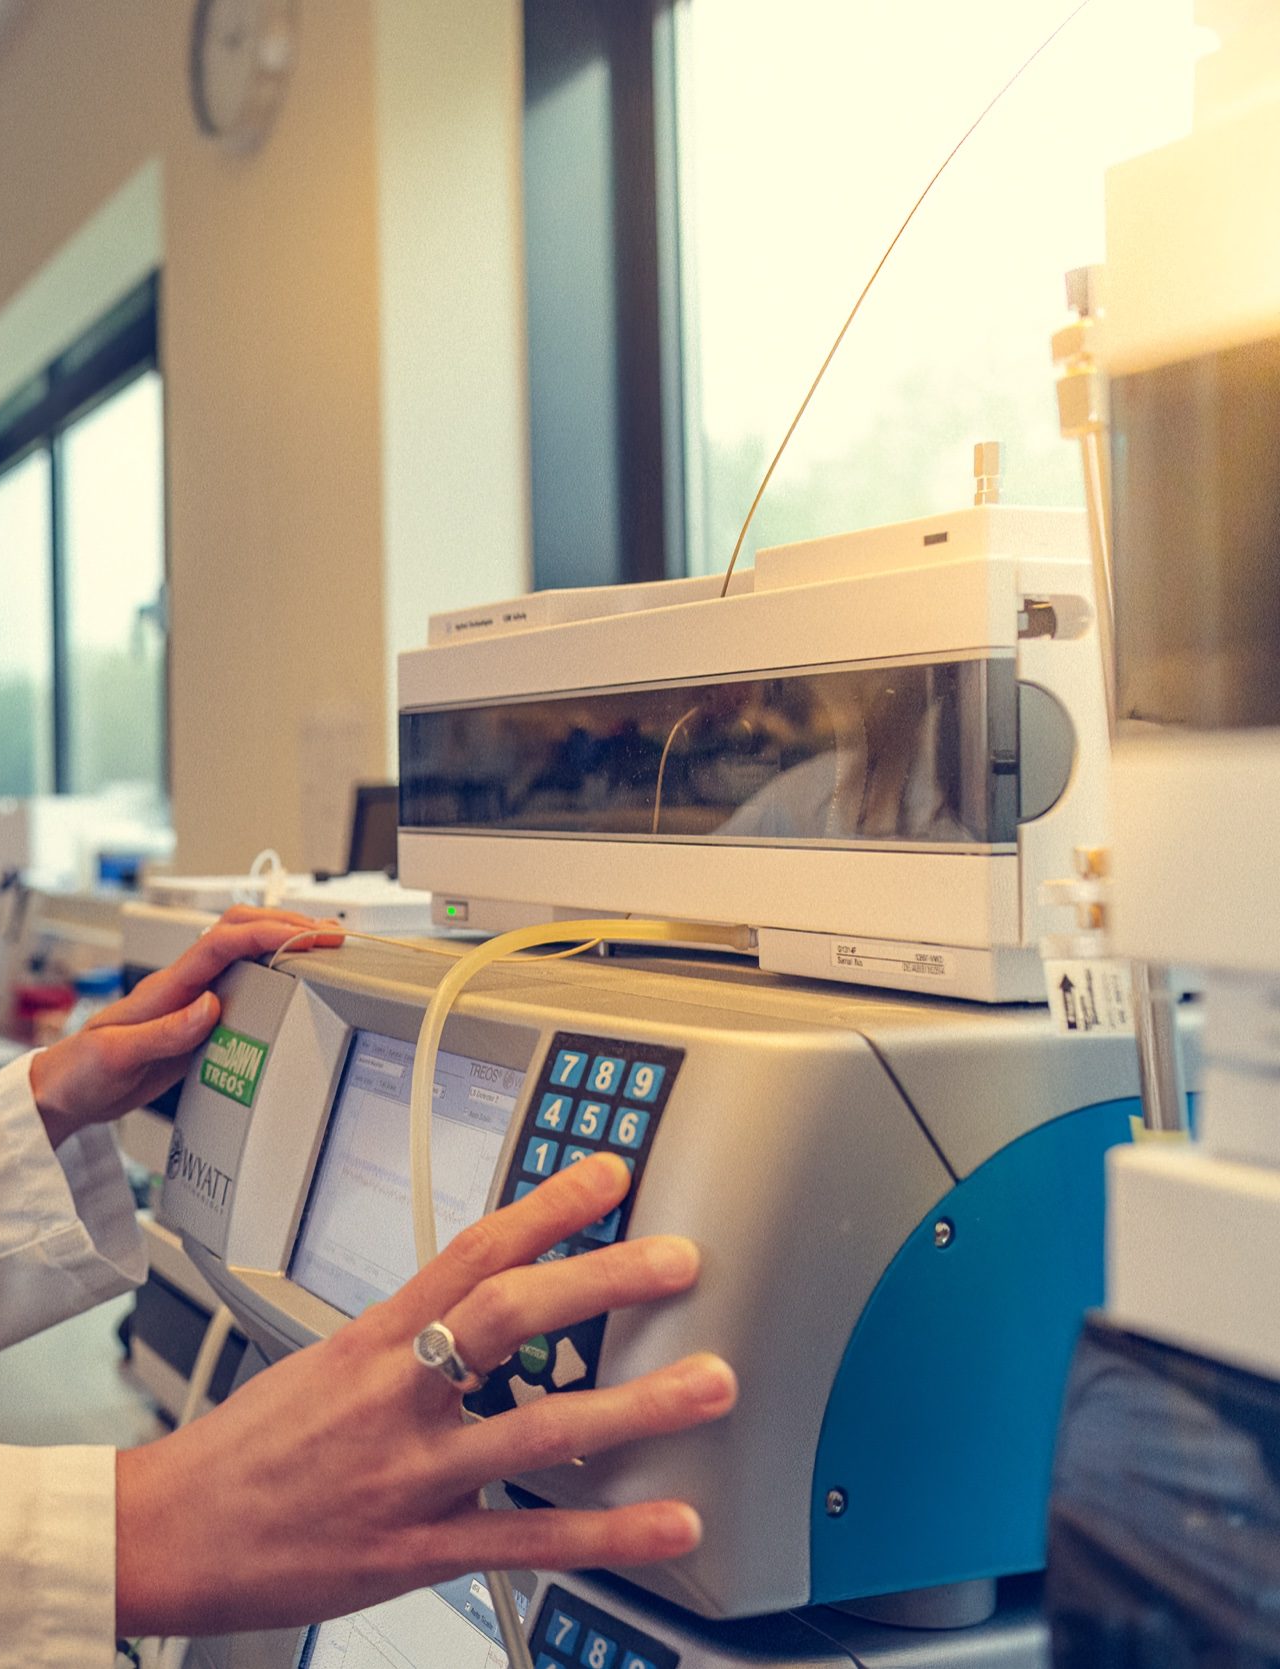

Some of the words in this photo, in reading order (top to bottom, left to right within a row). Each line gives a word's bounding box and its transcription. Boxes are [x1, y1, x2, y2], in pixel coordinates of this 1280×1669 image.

[204, 1063, 245, 1097] TREOS
[560, 1054, 580, 1083] 7
[595, 1061, 615, 1091] 8
[632, 1066, 654, 1098] 9
[544, 1098, 562, 1128] 4
[579, 1104, 600, 1135] 5
[618, 1113, 639, 1144] 6
[182, 1147, 232, 1206] WYATT
[535, 1143, 548, 1173] 1
[556, 1615, 573, 1647] 7
[588, 1637, 608, 1669] 8
